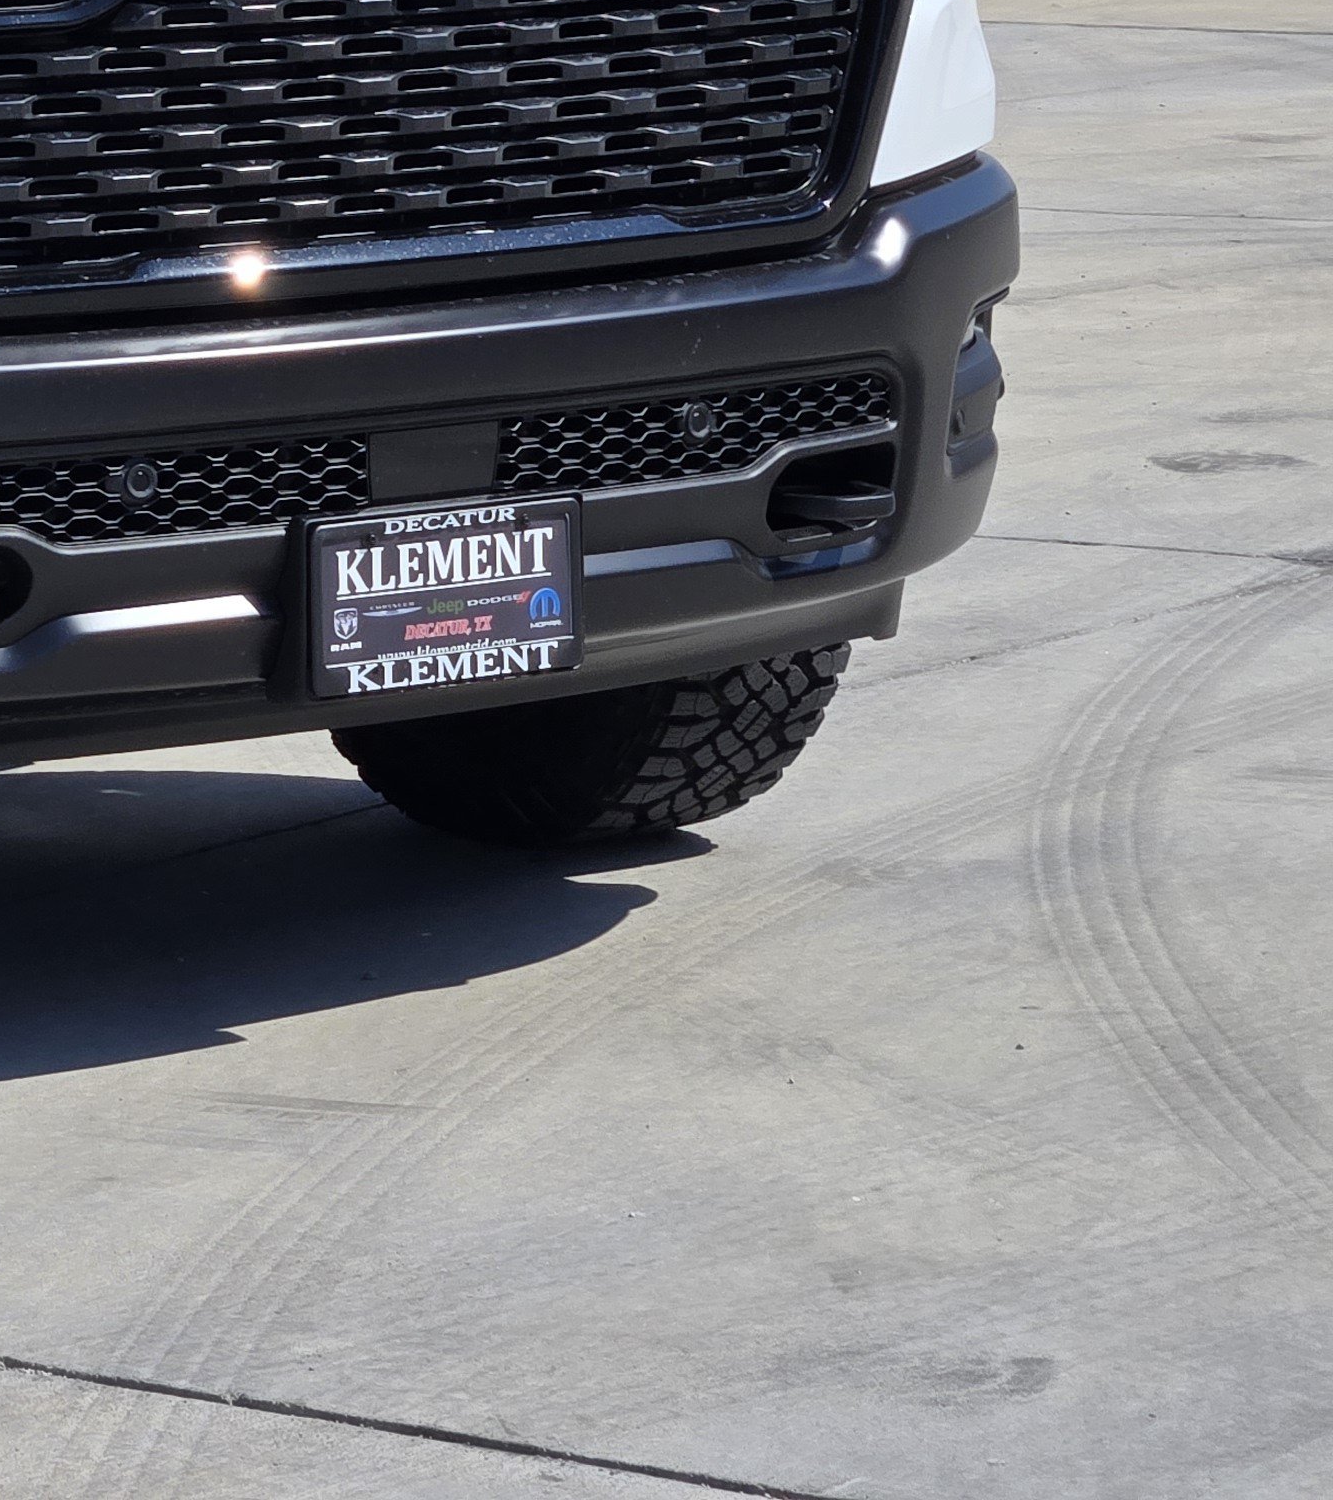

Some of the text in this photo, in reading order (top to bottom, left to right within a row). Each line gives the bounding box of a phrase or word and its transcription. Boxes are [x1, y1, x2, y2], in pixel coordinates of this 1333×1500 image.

[384, 506, 516, 536] DECATUR
[335, 526, 554, 596] KLEMENT
[426, 597, 465, 615] Jeep
[467, 593, 523, 607] DODGE
[404, 615, 493, 641] DECATUR, TX
[330, 640, 363, 652] RAM
[348, 640, 559, 694] KLEMENT
